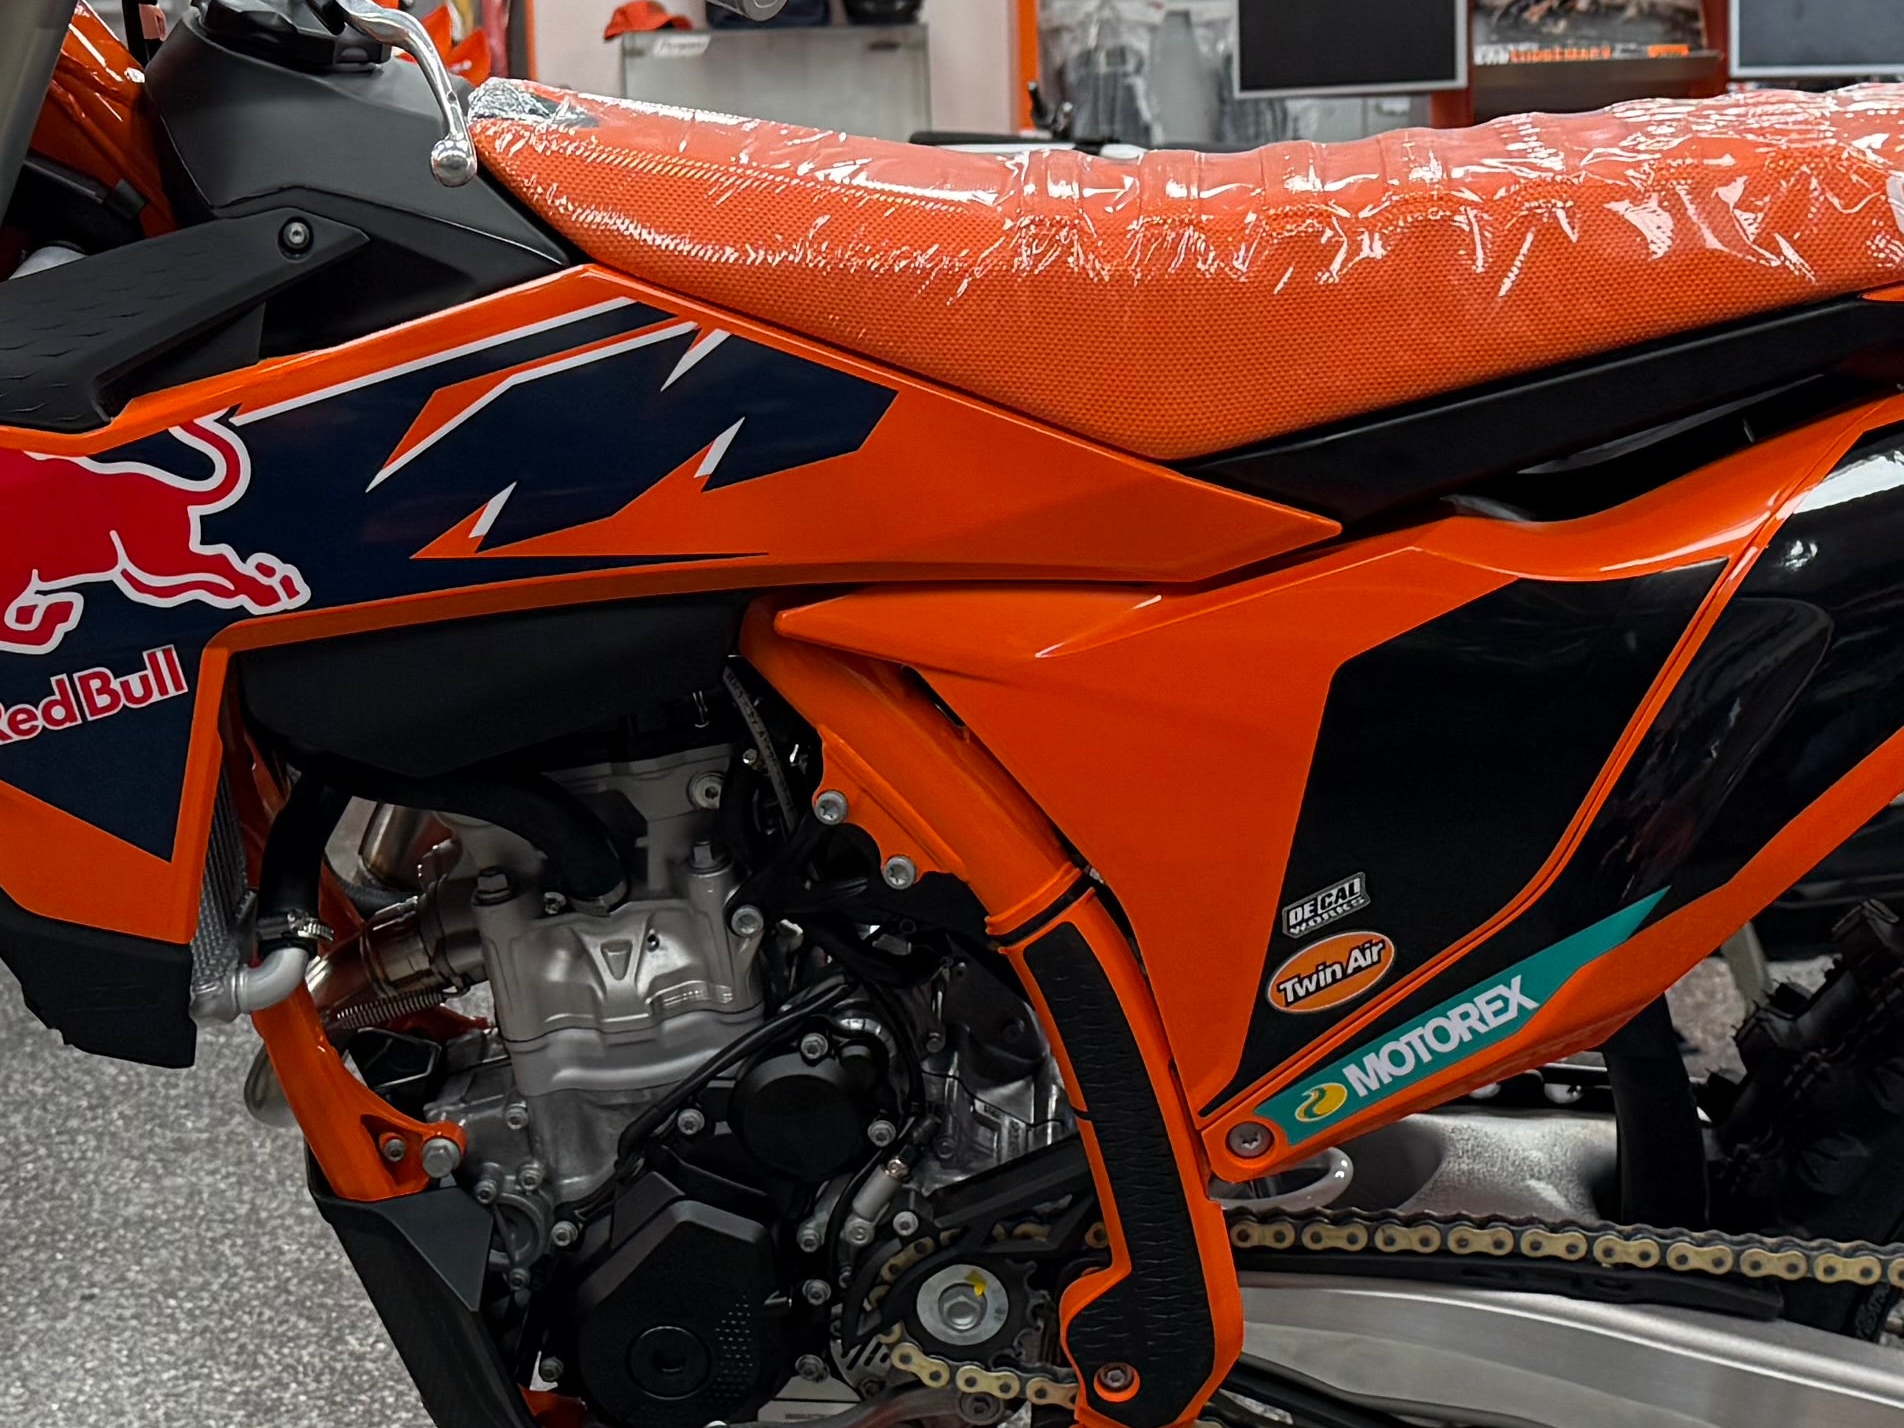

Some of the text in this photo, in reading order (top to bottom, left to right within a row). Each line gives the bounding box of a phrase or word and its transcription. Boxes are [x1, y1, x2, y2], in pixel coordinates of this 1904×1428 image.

[80, 644, 190, 723] Bull
[1278, 939, 1384, 1004] Twin Air
[1341, 974, 1540, 1099] MOTOREX
